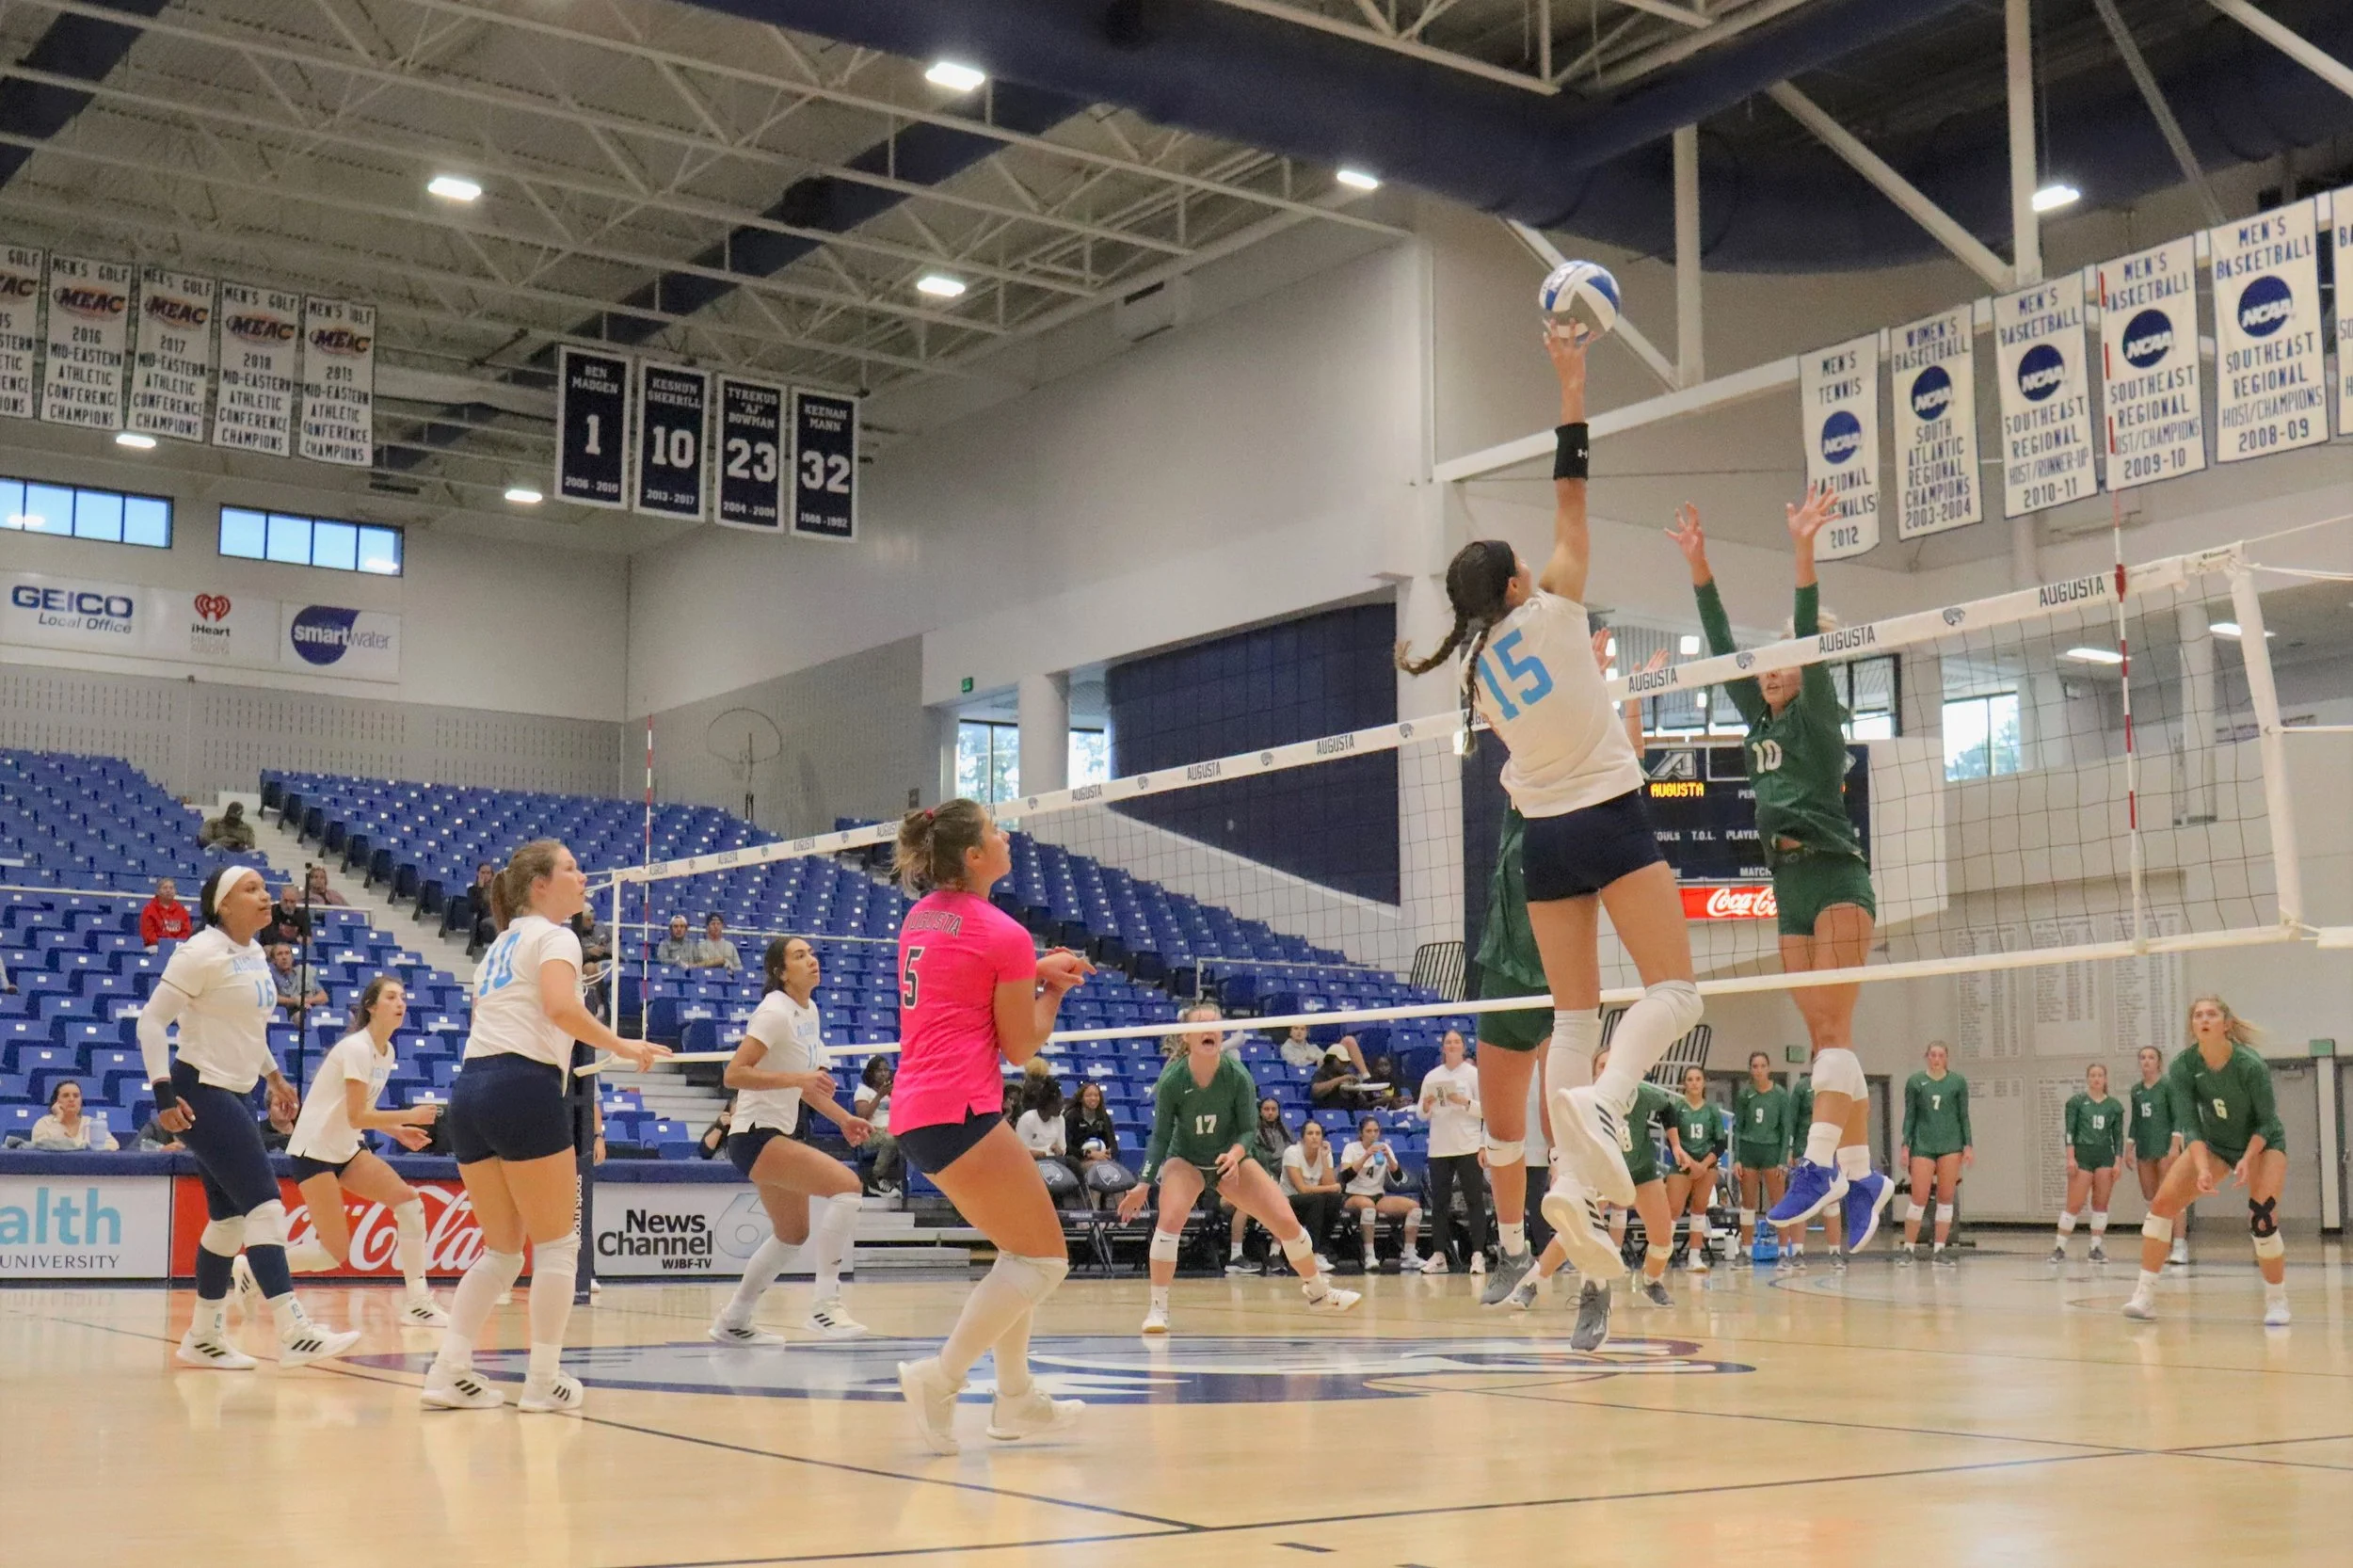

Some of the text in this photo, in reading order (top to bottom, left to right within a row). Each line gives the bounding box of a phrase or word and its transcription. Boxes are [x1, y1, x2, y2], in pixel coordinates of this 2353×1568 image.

[2239, 216, 2286, 248] MEN'S
[8, 249, 39, 267] GOLF
[2123, 252, 2167, 282] MEN'S
[2217, 235, 2312, 280] BASKETBALL
[98, 265, 128, 282] GOLF
[57, 286, 125, 313] MEAC
[183, 279, 210, 296] GOLF
[150, 295, 209, 324] MEAC
[268, 293, 296, 312] GOLF
[2018, 287, 2058, 316] MEN'S
[2242, 298, 2292, 328] NCAA
[72, 326, 102, 344] 2016
[232, 315, 296, 340] MEAC
[1906, 316, 1957, 347] WOMEN'S
[1999, 307, 2081, 346] BASKETBALL
[160, 335, 185, 354] 2017
[314, 329, 371, 353] MEAC
[1895, 334, 1970, 372] BASKETBALL
[2126, 330, 2174, 360] NCAA
[2226, 331, 2315, 374] SOUTHEAST
[51, 343, 121, 366] MID-EASTERN
[138, 352, 205, 376] MID-EASTERN
[1822, 350, 1856, 376] MEN'S
[58, 364, 112, 386] ATHLETIC
[146, 372, 196, 395] ATHLETIC
[223, 368, 291, 392] MID-EASTERN
[2022, 365, 2065, 393] NCAA
[2110, 365, 2195, 405] SOUTHEAST
[2233, 363, 2309, 400] REGIONAL
[230, 391, 281, 410] ATHLETIC
[304, 383, 369, 405] MID-EASTERN
[1819, 377, 1862, 405] TENNIS
[1914, 386, 1953, 412] NCAA
[50, 404, 114, 425] CHAMPIONS
[311, 404, 360, 423] ATHLETIC
[2005, 395, 2085, 436] SOUTHEAST
[2118, 393, 2190, 429] REGIONAL
[2222, 385, 2323, 428] HOST/CHAMPIONS
[136, 413, 198, 436] CHAMPIONS
[219, 407, 287, 433] CONFERENCE
[304, 421, 368, 443] CONFERENCE
[728, 412, 775, 429] BOWMAN
[1915, 420, 1952, 444] SOUTH
[221, 427, 282, 451] CHAMPIONS
[585, 414, 600, 456] 1
[651, 425, 695, 469] 10
[2012, 426, 2081, 460] REGIONAL
[2114, 417, 2201, 456] OST/CHAMPIONS
[2239, 418, 2309, 453] 2008-09
[305, 440, 363, 461] CHAMPIONS
[727, 438, 776, 483] 23
[1908, 438, 1964, 468] ATLANTIC
[801, 450, 851, 494] 32
[1908, 458, 1964, 488] REGIONAL
[2009, 447, 2089, 487] HOST/RUNNER-UP
[2124, 448, 2186, 480] 2009-10
[1905, 477, 1970, 509] CHAMPIONS
[2024, 478, 2078, 509] 2010-11
[1905, 497, 1971, 530] 2003-2004
[1831, 525, 1859, 549] 2012
[11, 584, 134, 618] GEICO
[2040, 576, 2105, 608] AUGUSTA
[39, 612, 132, 634] Local Office
[191, 623, 231, 637] iHeart
[1818, 625, 1875, 654] AUGUSTA
[1479, 629, 1553, 721] 15
[1628, 666, 1678, 692] AUGUSTA
[1316, 734, 1355, 755] AUGUSTA
[1752, 739, 1783, 774] 10
[1187, 760, 1222, 781] AUGUSTA
[1071, 784, 1102, 803] AUGUSTA
[1651, 782, 1705, 798] AUGUSTA
[1691, 830, 1716, 840] T.O.L.
[904, 946, 925, 1009] 5
[255, 979, 274, 1007] 16
[1932, 1095, 1941, 1111] 7
[2141, 1102, 2152, 1117] 15
[2213, 1098, 2228, 1119] 6
[1195, 1114, 1217, 1135] 17
[1690, 1124, 1704, 1138] 13
[2092, 1115, 2105, 1129] 19
[626, 1209, 706, 1233] News
[598, 1230, 712, 1256] Channel
[0, 1255, 120, 1269] UNIVERSITY
[662, 1258, 712, 1269] WJBF-TV
